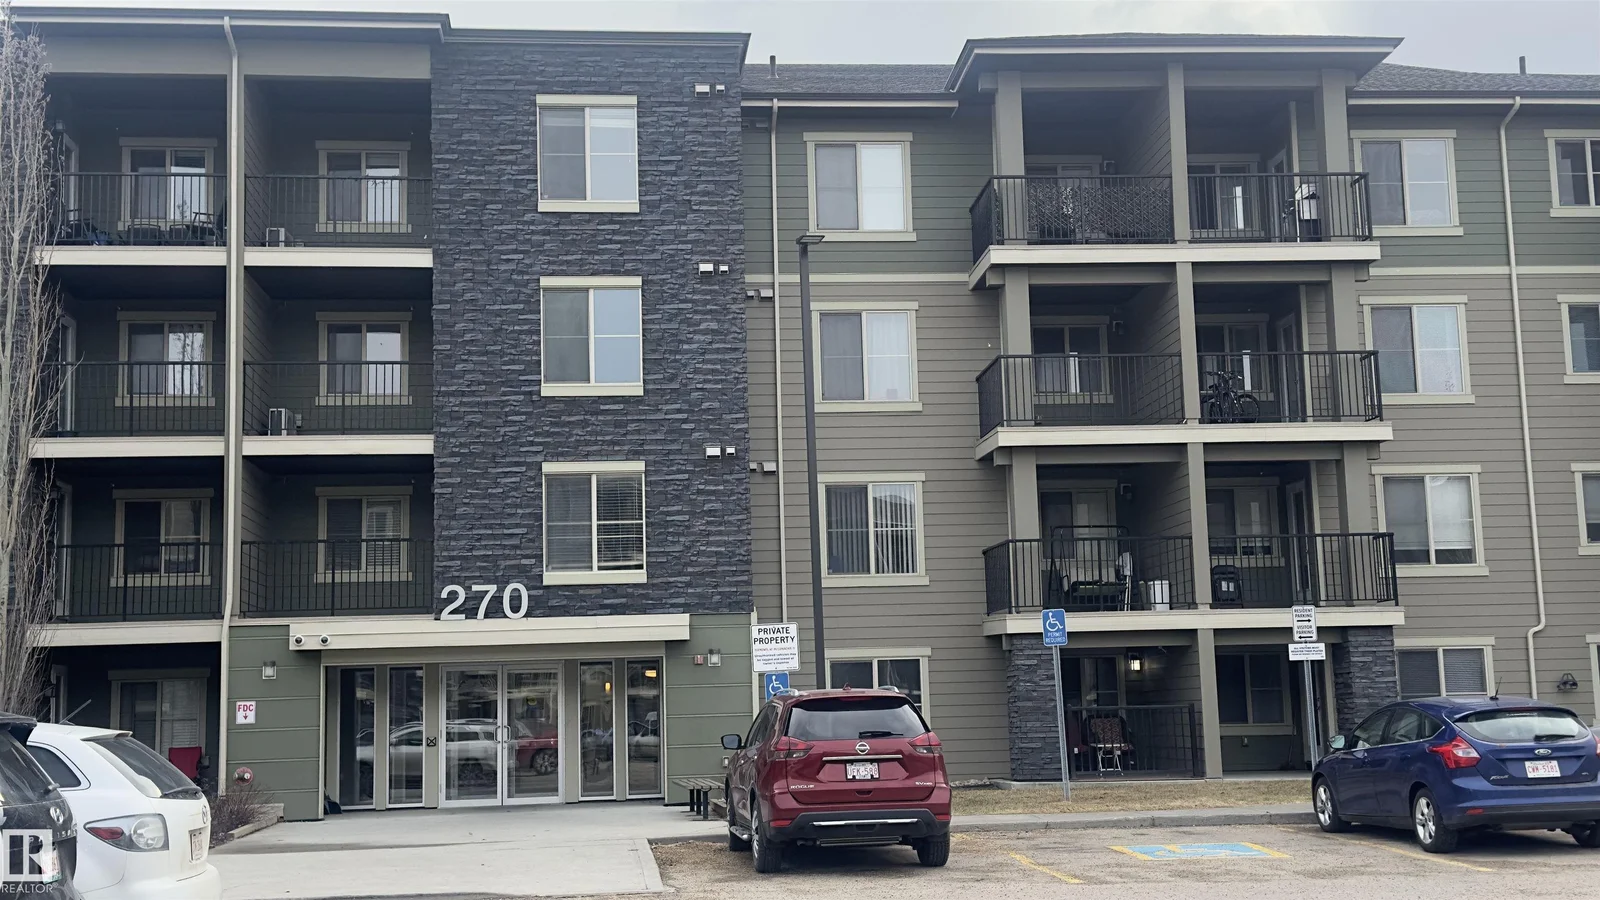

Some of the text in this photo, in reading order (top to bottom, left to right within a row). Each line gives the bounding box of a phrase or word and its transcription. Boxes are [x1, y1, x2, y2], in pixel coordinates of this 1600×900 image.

[440, 583, 529, 620] 270
[757, 626, 790, 636] PRIVATE
[753, 635, 796, 645] PROPERTY
[237, 704, 254, 712] FDC
[1527, 764, 1558, 774] CWM-5181
